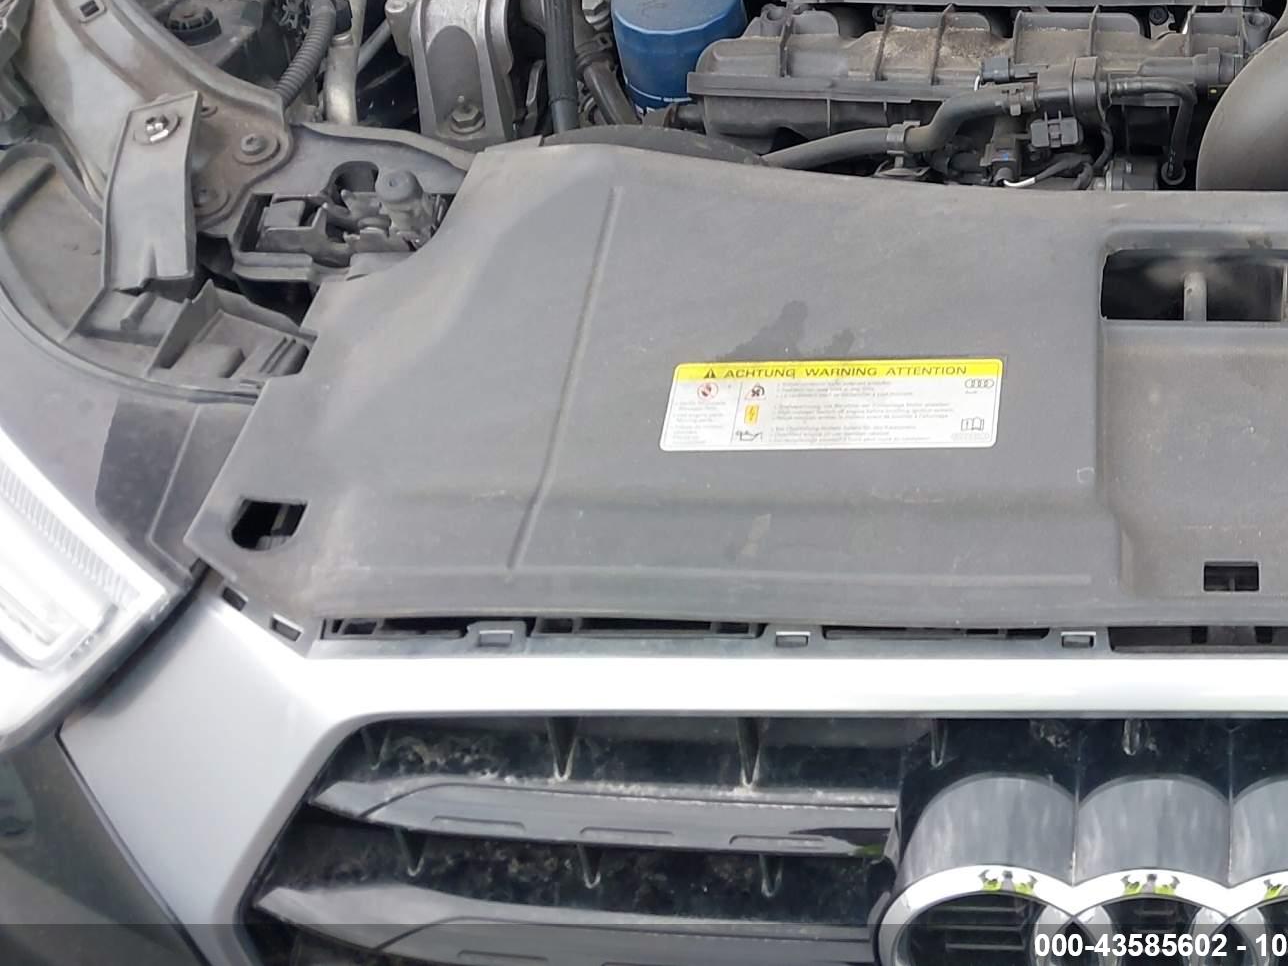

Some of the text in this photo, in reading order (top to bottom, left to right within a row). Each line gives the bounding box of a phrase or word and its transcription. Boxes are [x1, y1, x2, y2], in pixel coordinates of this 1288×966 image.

[724, 366, 967, 379] ACHTUNG WARNING ATTENTION
